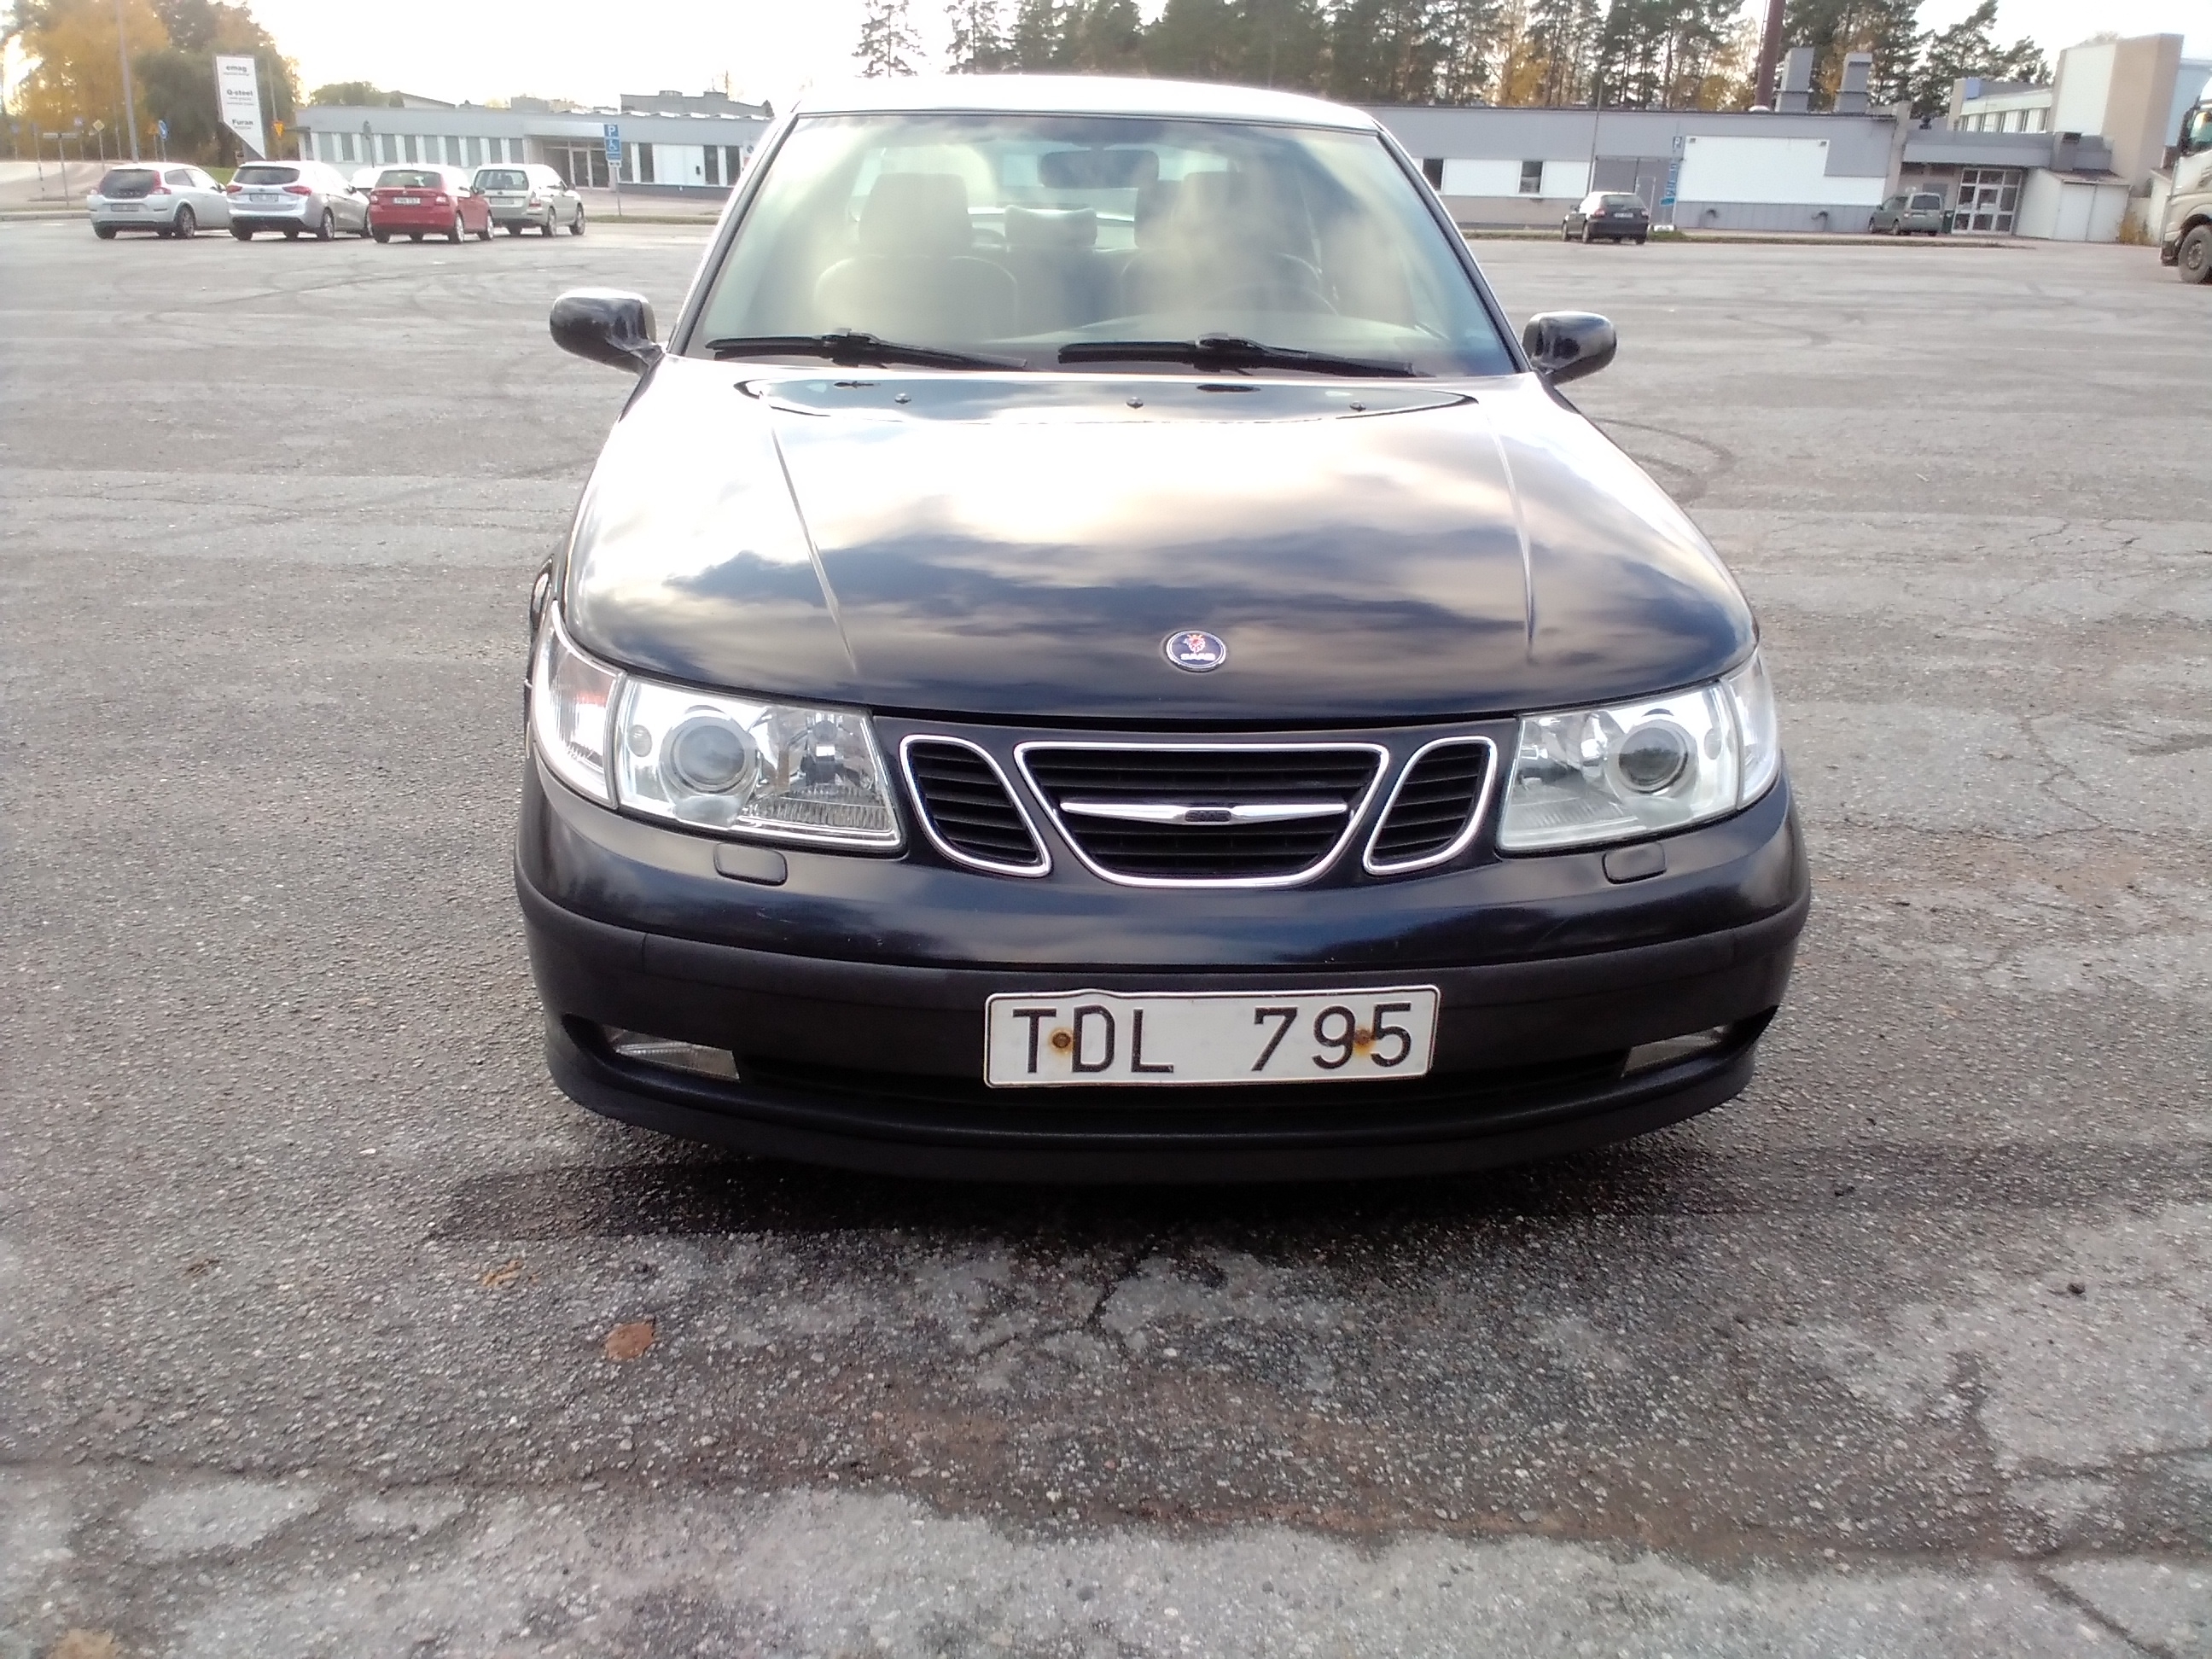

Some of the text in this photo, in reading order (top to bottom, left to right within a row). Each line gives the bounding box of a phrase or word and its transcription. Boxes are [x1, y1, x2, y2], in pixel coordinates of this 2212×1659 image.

[608, 125, 615, 137] P
[1012, 1001, 1412, 1074] TDL 795
